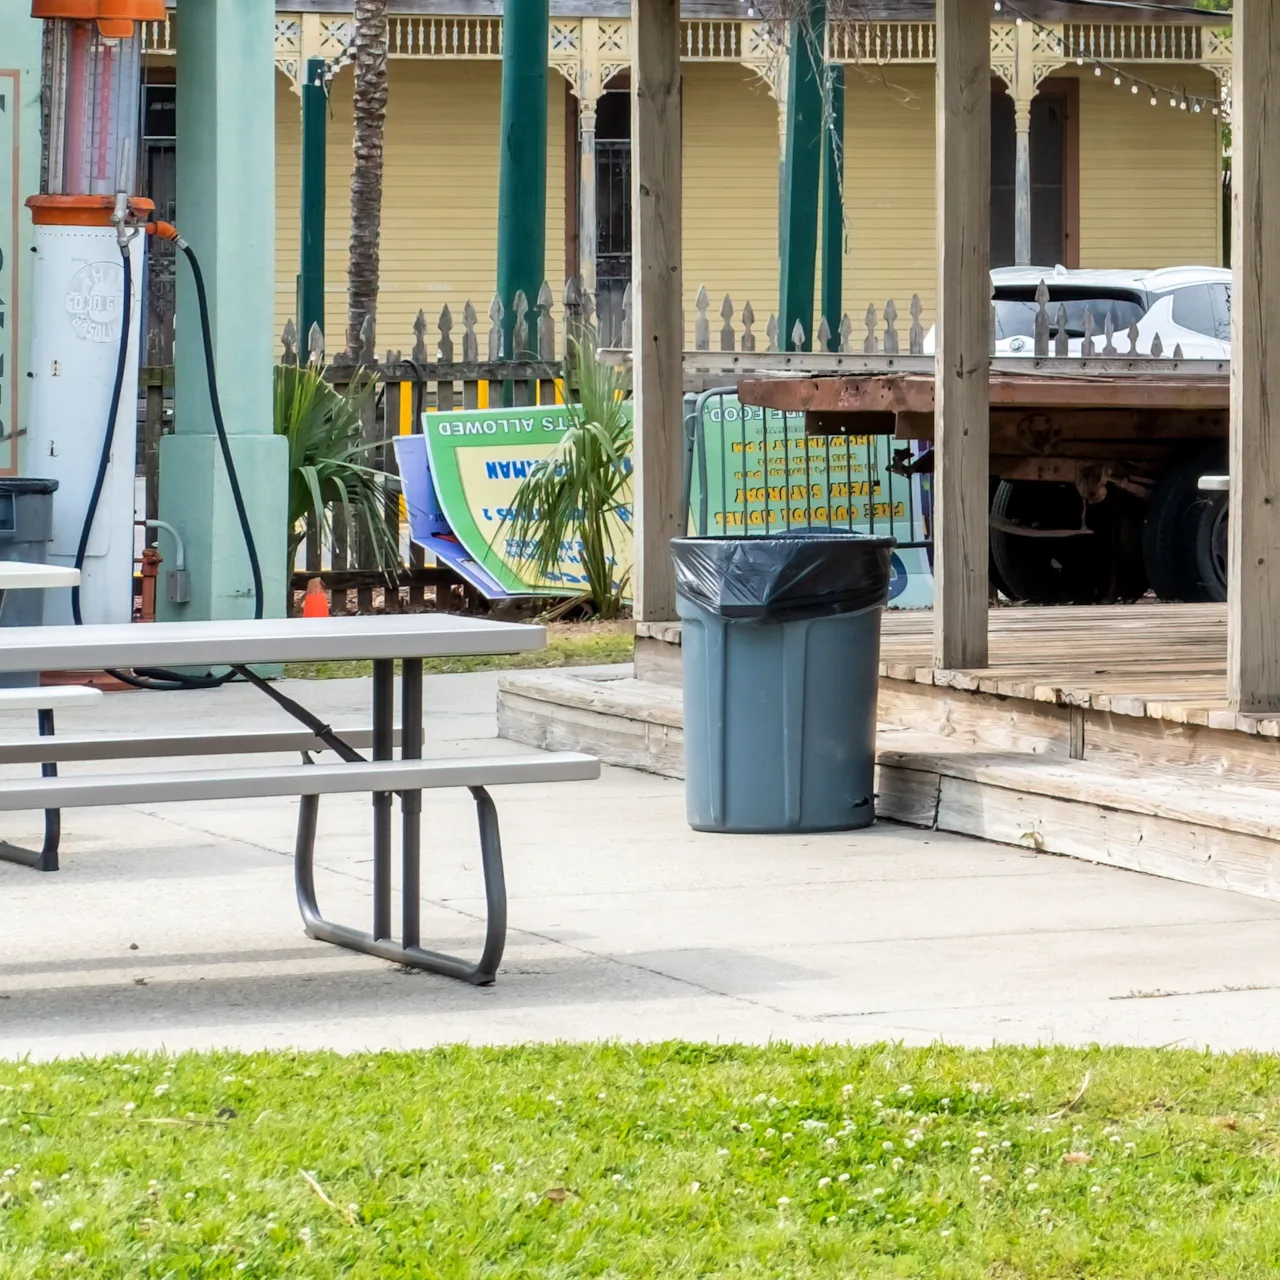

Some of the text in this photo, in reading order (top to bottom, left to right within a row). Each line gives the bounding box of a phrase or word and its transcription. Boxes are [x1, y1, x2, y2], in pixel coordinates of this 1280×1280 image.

[438, 418, 535, 436] ALLOWED
[731, 442, 756, 454] PM
[734, 481, 882, 503] EVERY SATURDAY
[863, 501, 905, 519] FREE
